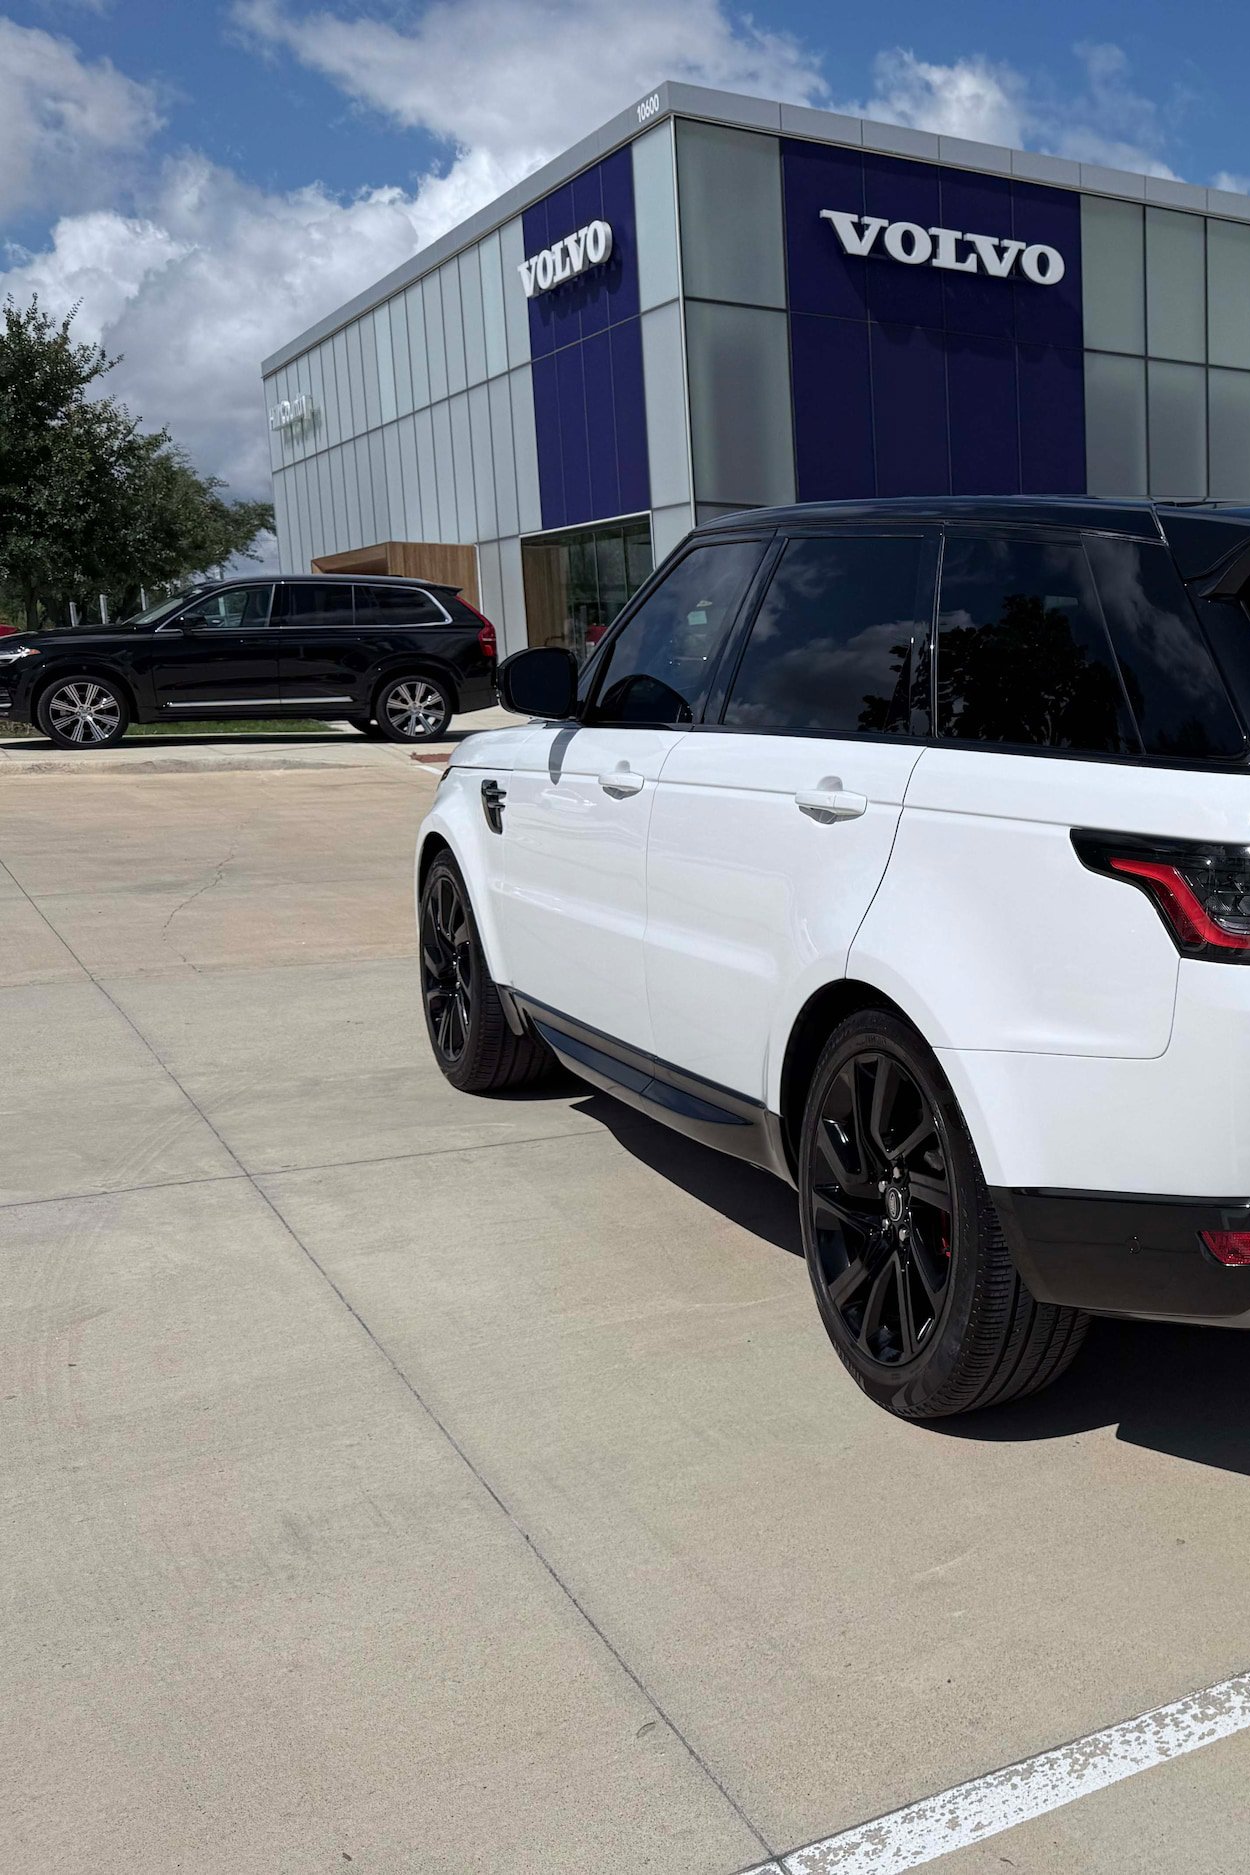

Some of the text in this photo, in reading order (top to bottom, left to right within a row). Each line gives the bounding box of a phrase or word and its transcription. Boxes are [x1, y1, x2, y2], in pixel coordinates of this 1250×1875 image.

[637, 93, 660, 123] 10600
[517, 219, 613, 299] VOLVO
[819, 208, 1066, 286] VOLVO
